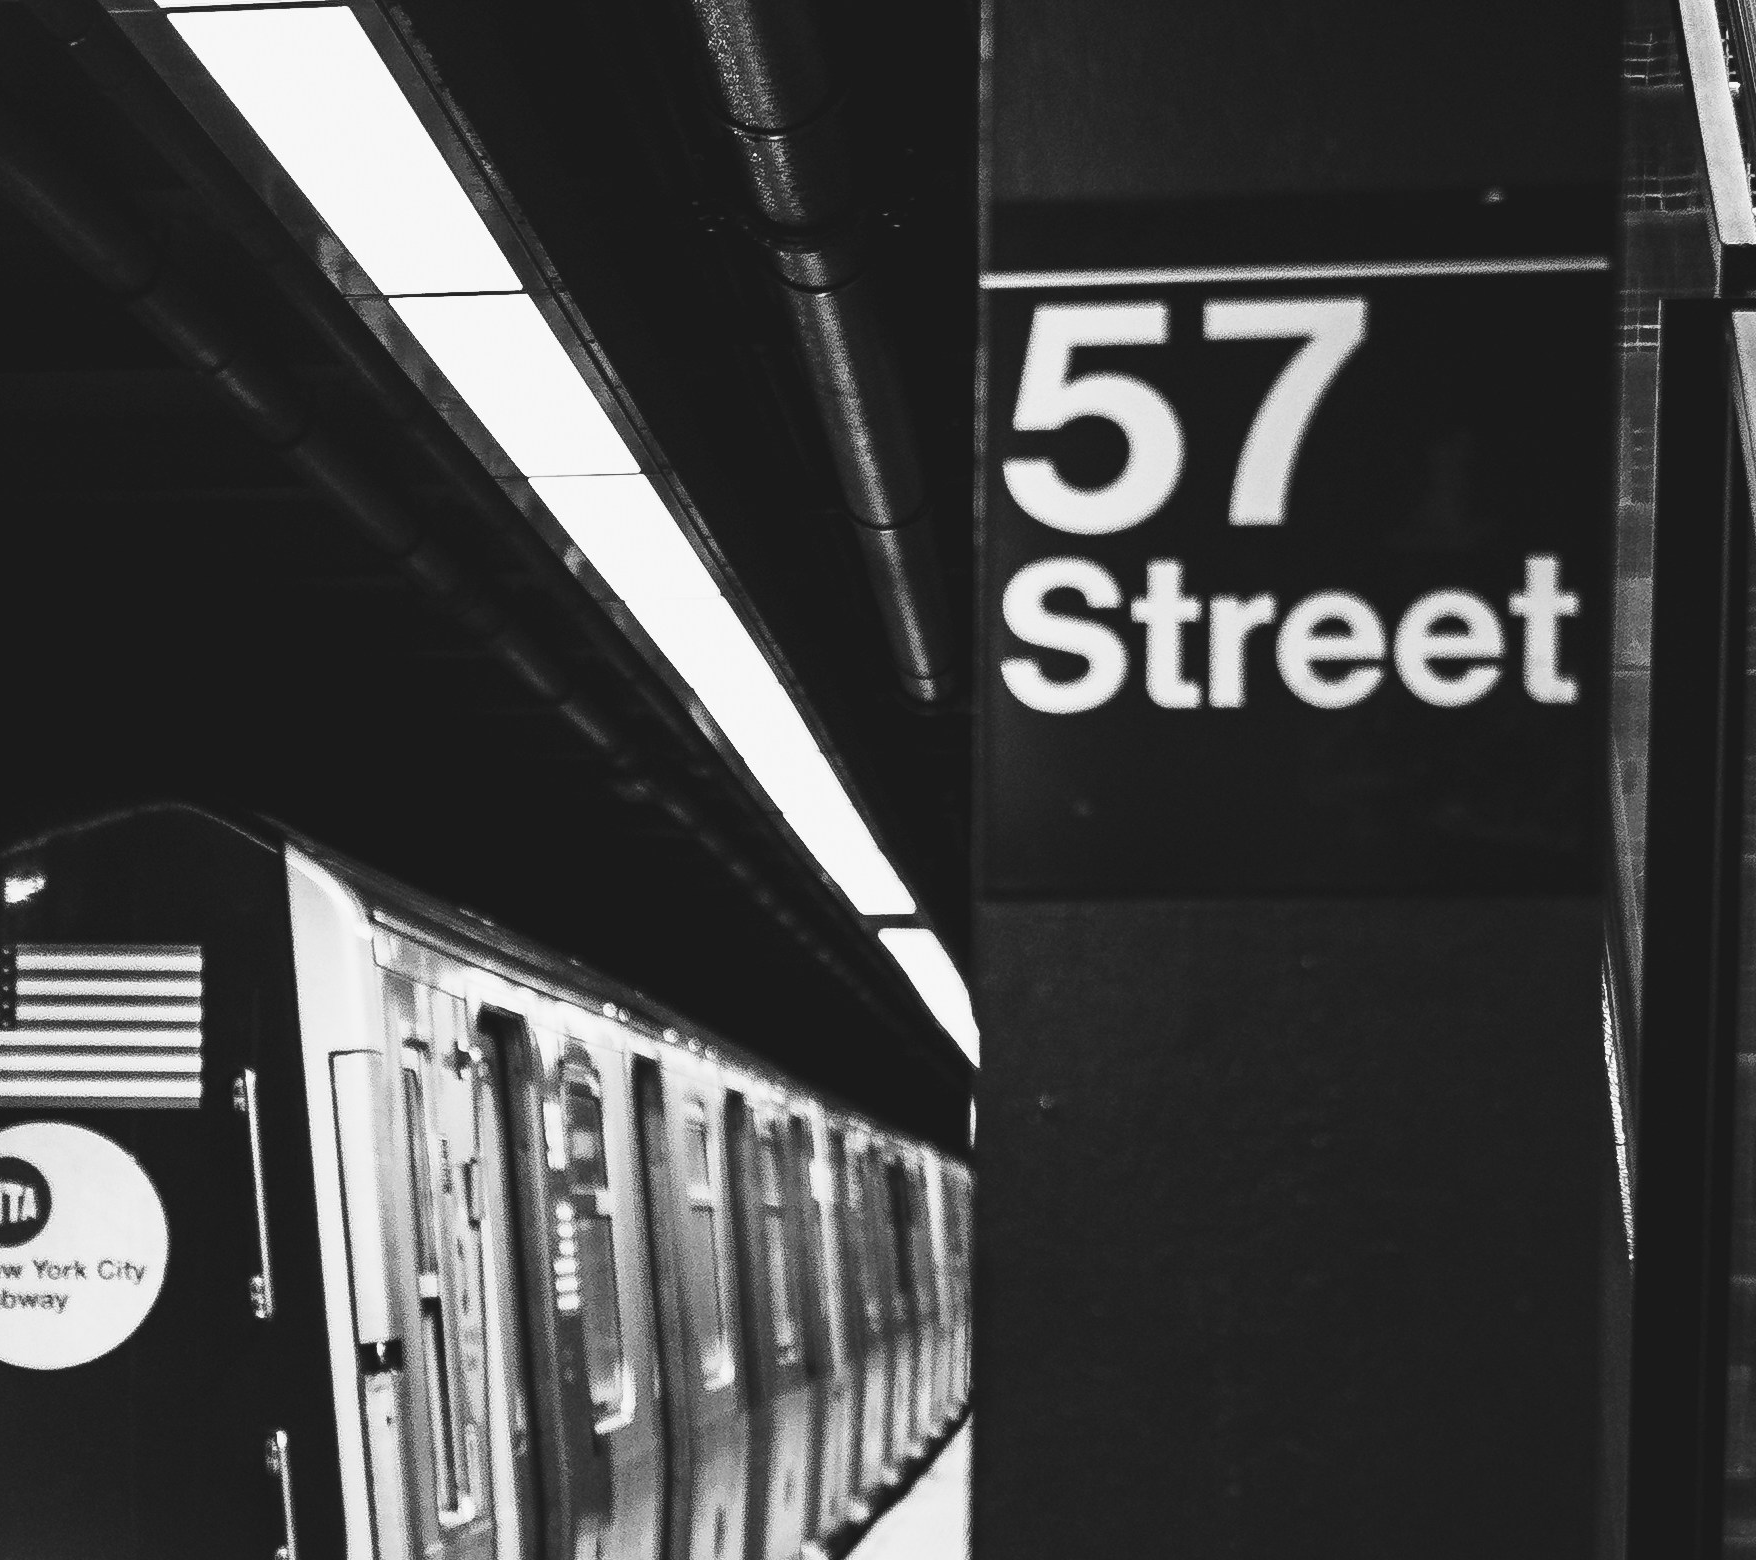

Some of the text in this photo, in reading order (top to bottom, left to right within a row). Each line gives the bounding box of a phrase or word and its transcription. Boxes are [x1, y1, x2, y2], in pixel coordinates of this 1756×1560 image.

[1001, 298, 1369, 536] 57
[1000, 552, 1581, 715] Street
[32, 1257, 87, 1280] York
[96, 1258, 147, 1286] City
